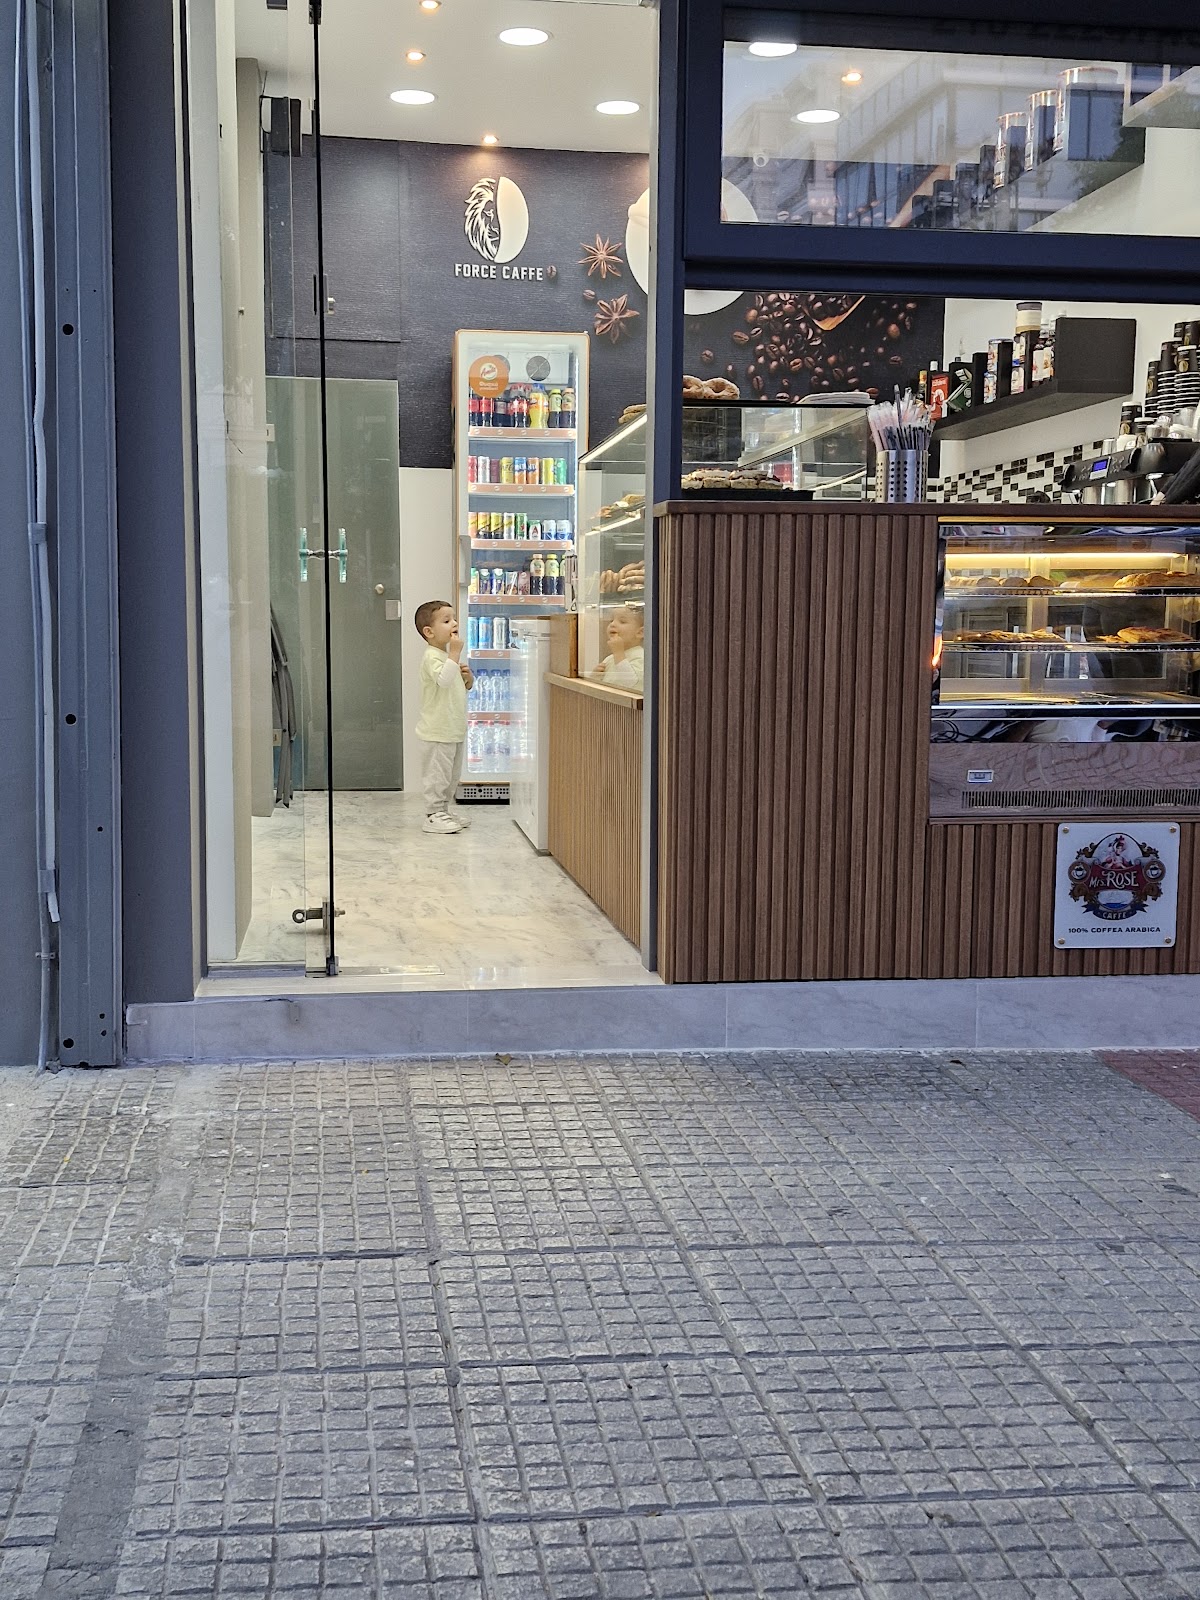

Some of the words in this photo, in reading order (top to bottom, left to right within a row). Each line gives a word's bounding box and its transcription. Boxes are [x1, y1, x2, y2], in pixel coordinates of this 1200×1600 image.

[455, 263, 496, 279] FORCE
[502, 265, 543, 280] CAFFE
[1089, 876, 1106, 887] Mrs.
[1102, 871, 1139, 889] ROSE
[1102, 911, 1127, 919] CAFFE
